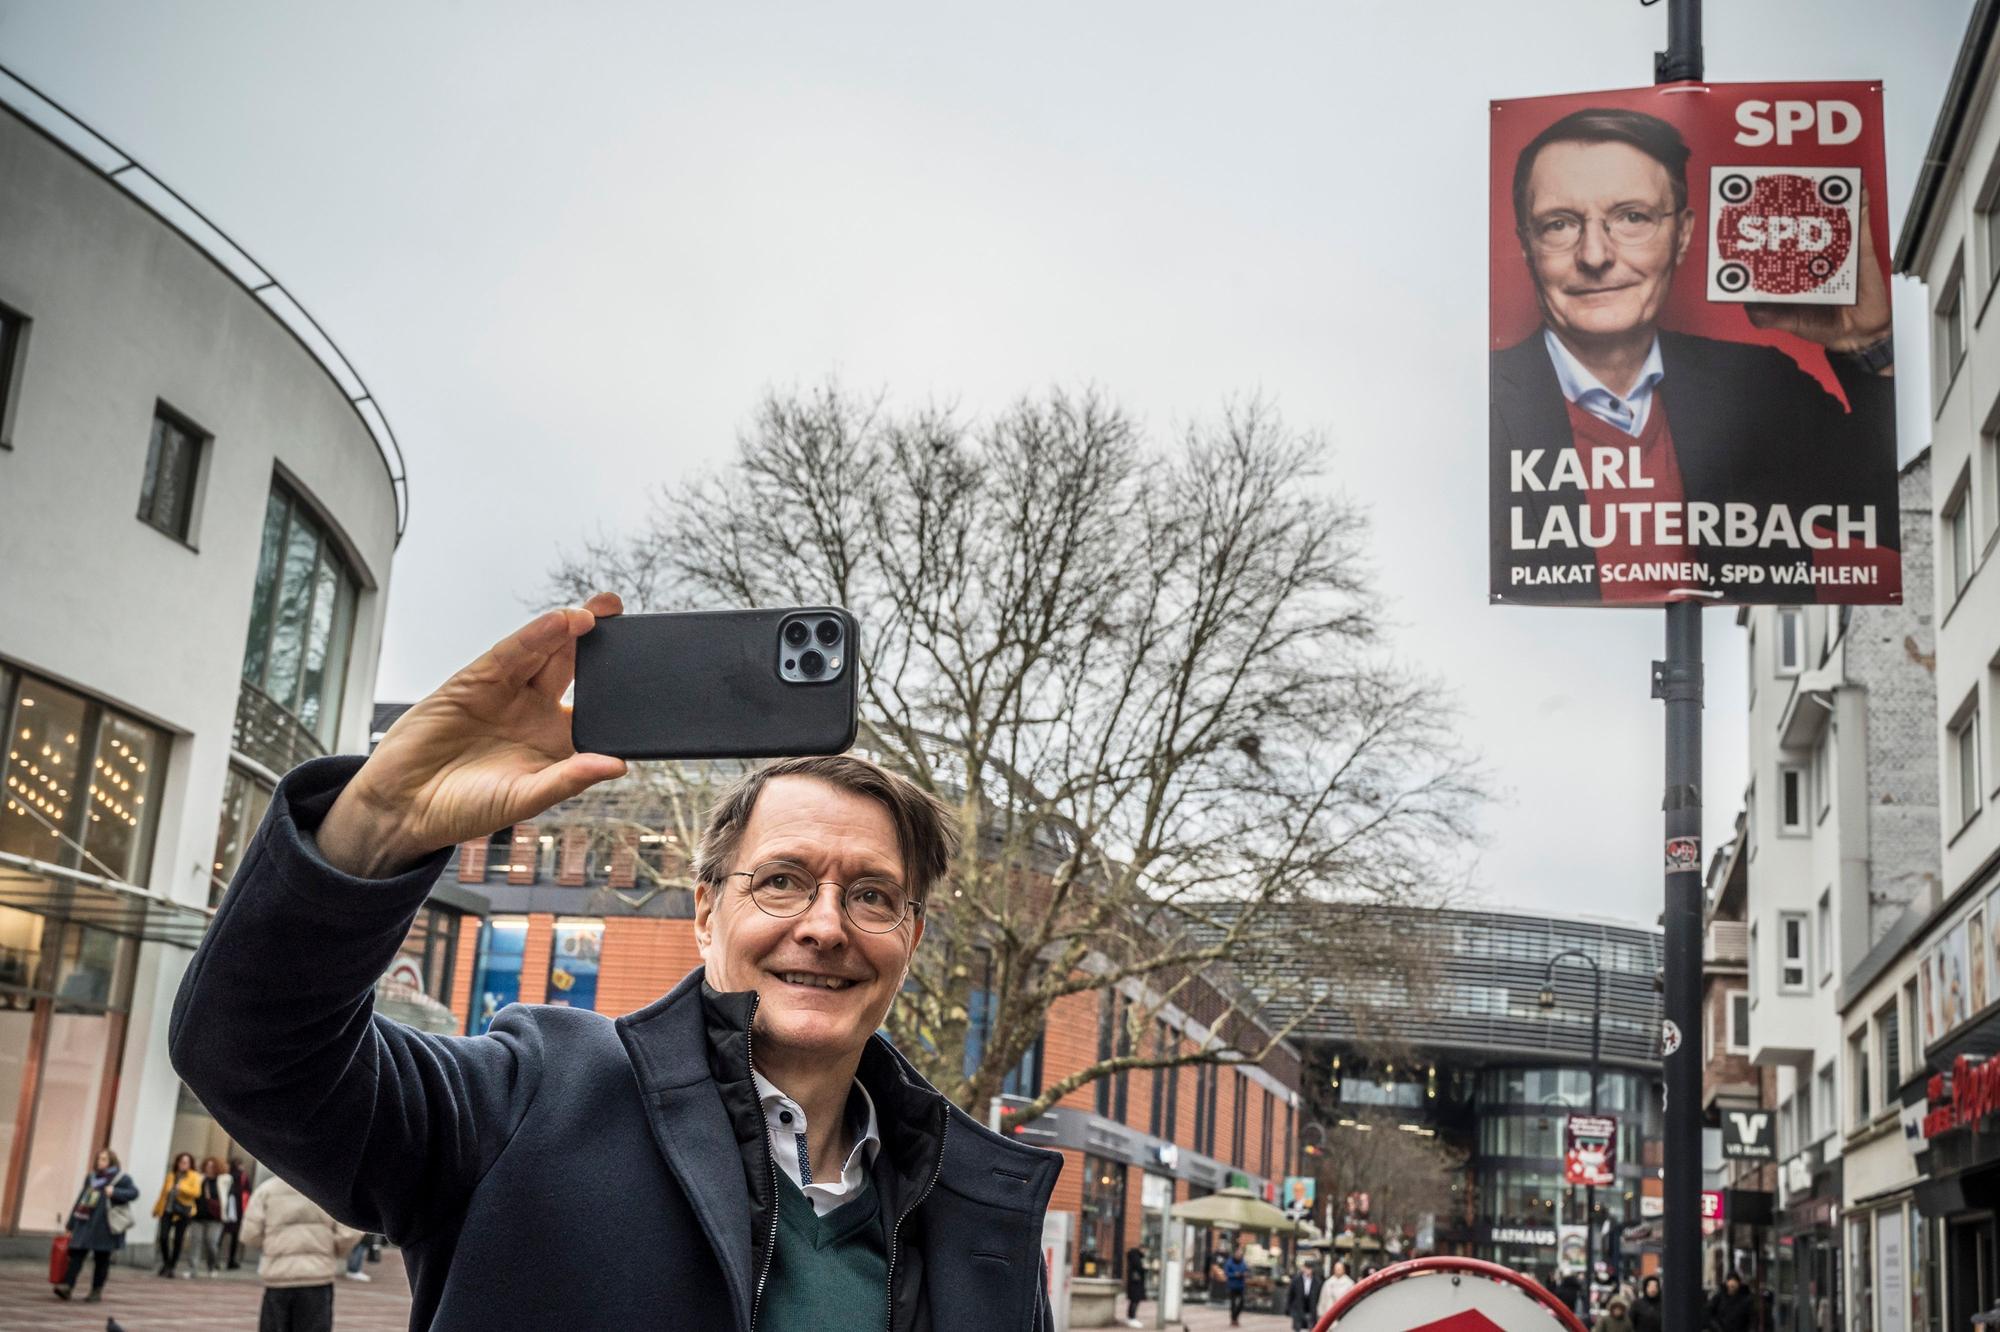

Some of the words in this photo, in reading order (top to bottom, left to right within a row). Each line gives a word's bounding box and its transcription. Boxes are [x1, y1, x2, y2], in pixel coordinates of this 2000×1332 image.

[1734, 100, 1862, 147] SPD
[1737, 215, 1833, 252] SPD
[1510, 446, 1655, 492] KARL
[1510, 502, 1878, 551] LAUTERBACH
[1510, 565, 1596, 586] PLAKAT
[1600, 562, 1716, 587] SCANNEN,
[1720, 564, 1765, 584] SPD
[1769, 561, 1879, 585] WÄHLEN!
[1491, 1228, 1556, 1245] RATHAUS
